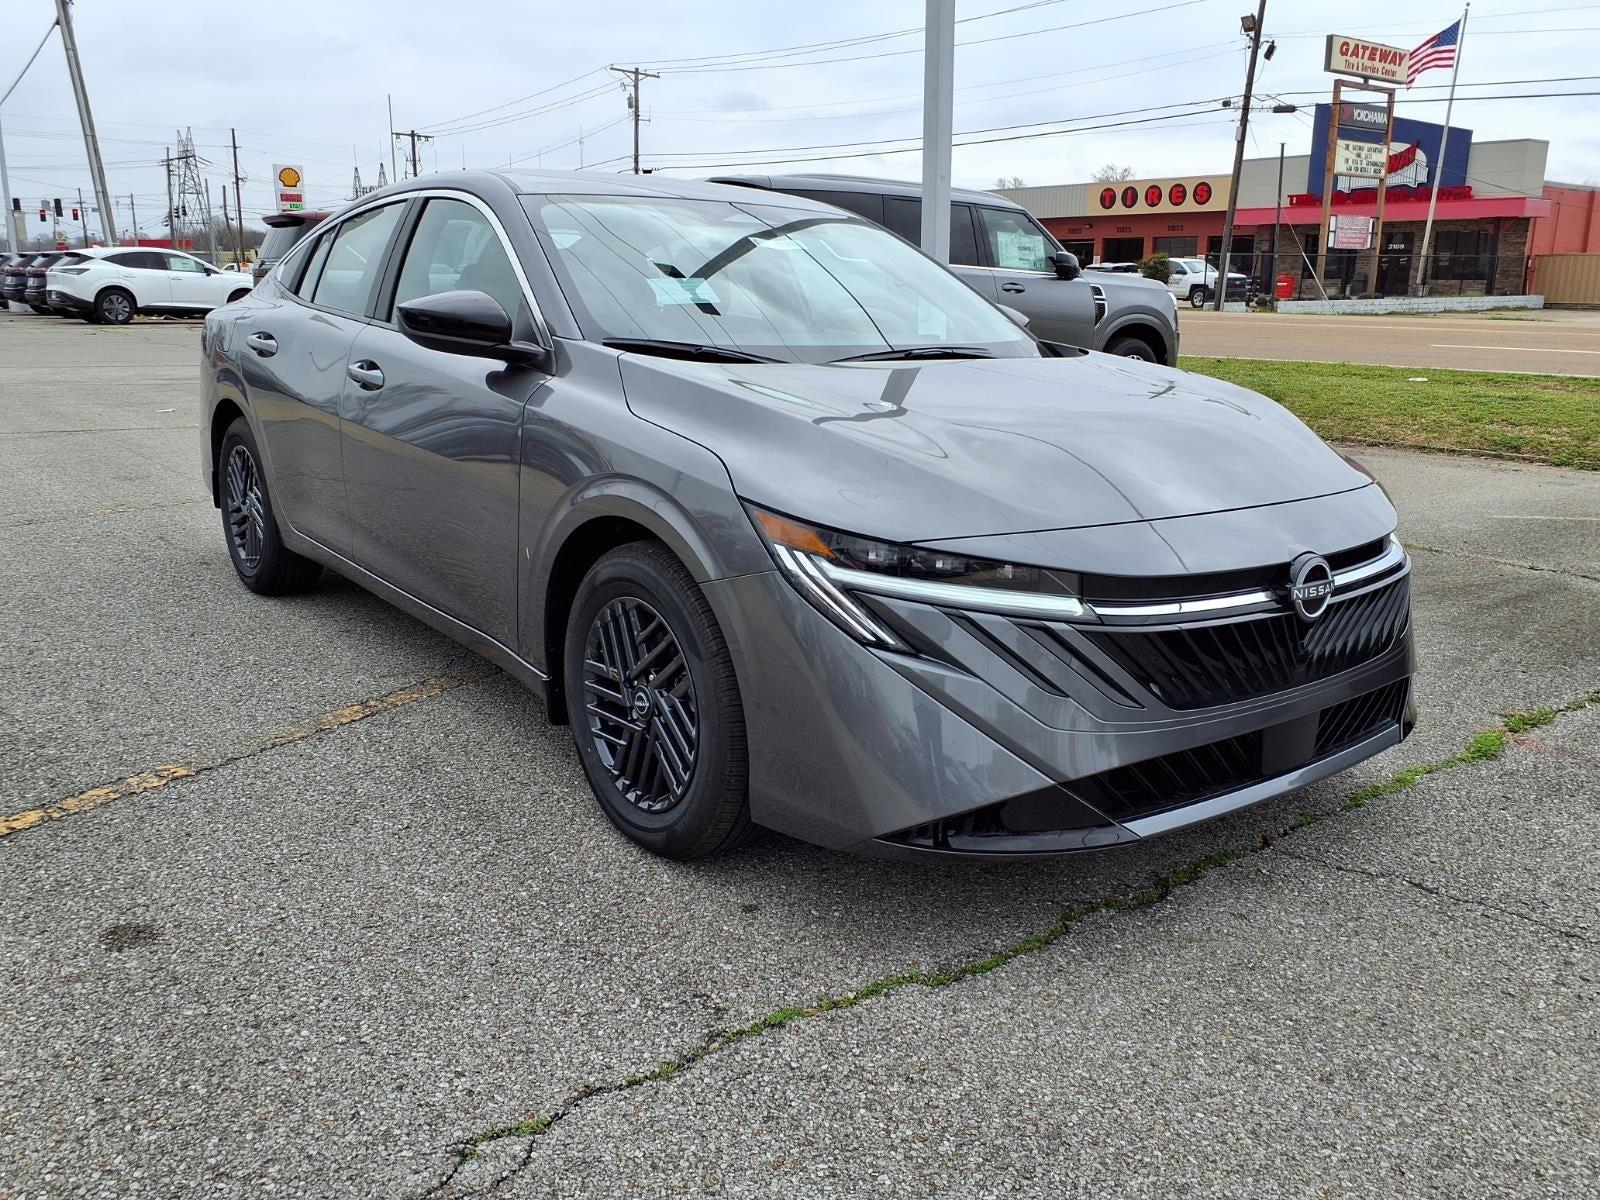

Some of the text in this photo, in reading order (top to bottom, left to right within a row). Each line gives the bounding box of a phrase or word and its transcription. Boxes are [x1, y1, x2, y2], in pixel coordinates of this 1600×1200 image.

[1339, 41, 1407, 67] GATEWAY
[1344, 59, 1355, 70] Tire
[1360, 62, 1380, 74] Service
[1381, 66, 1398, 77] Center
[1353, 108, 1388, 125] YOKOHAMA
[1102, 183, 1210, 207] TIRES
[1293, 582, 1335, 599] NISSAN
